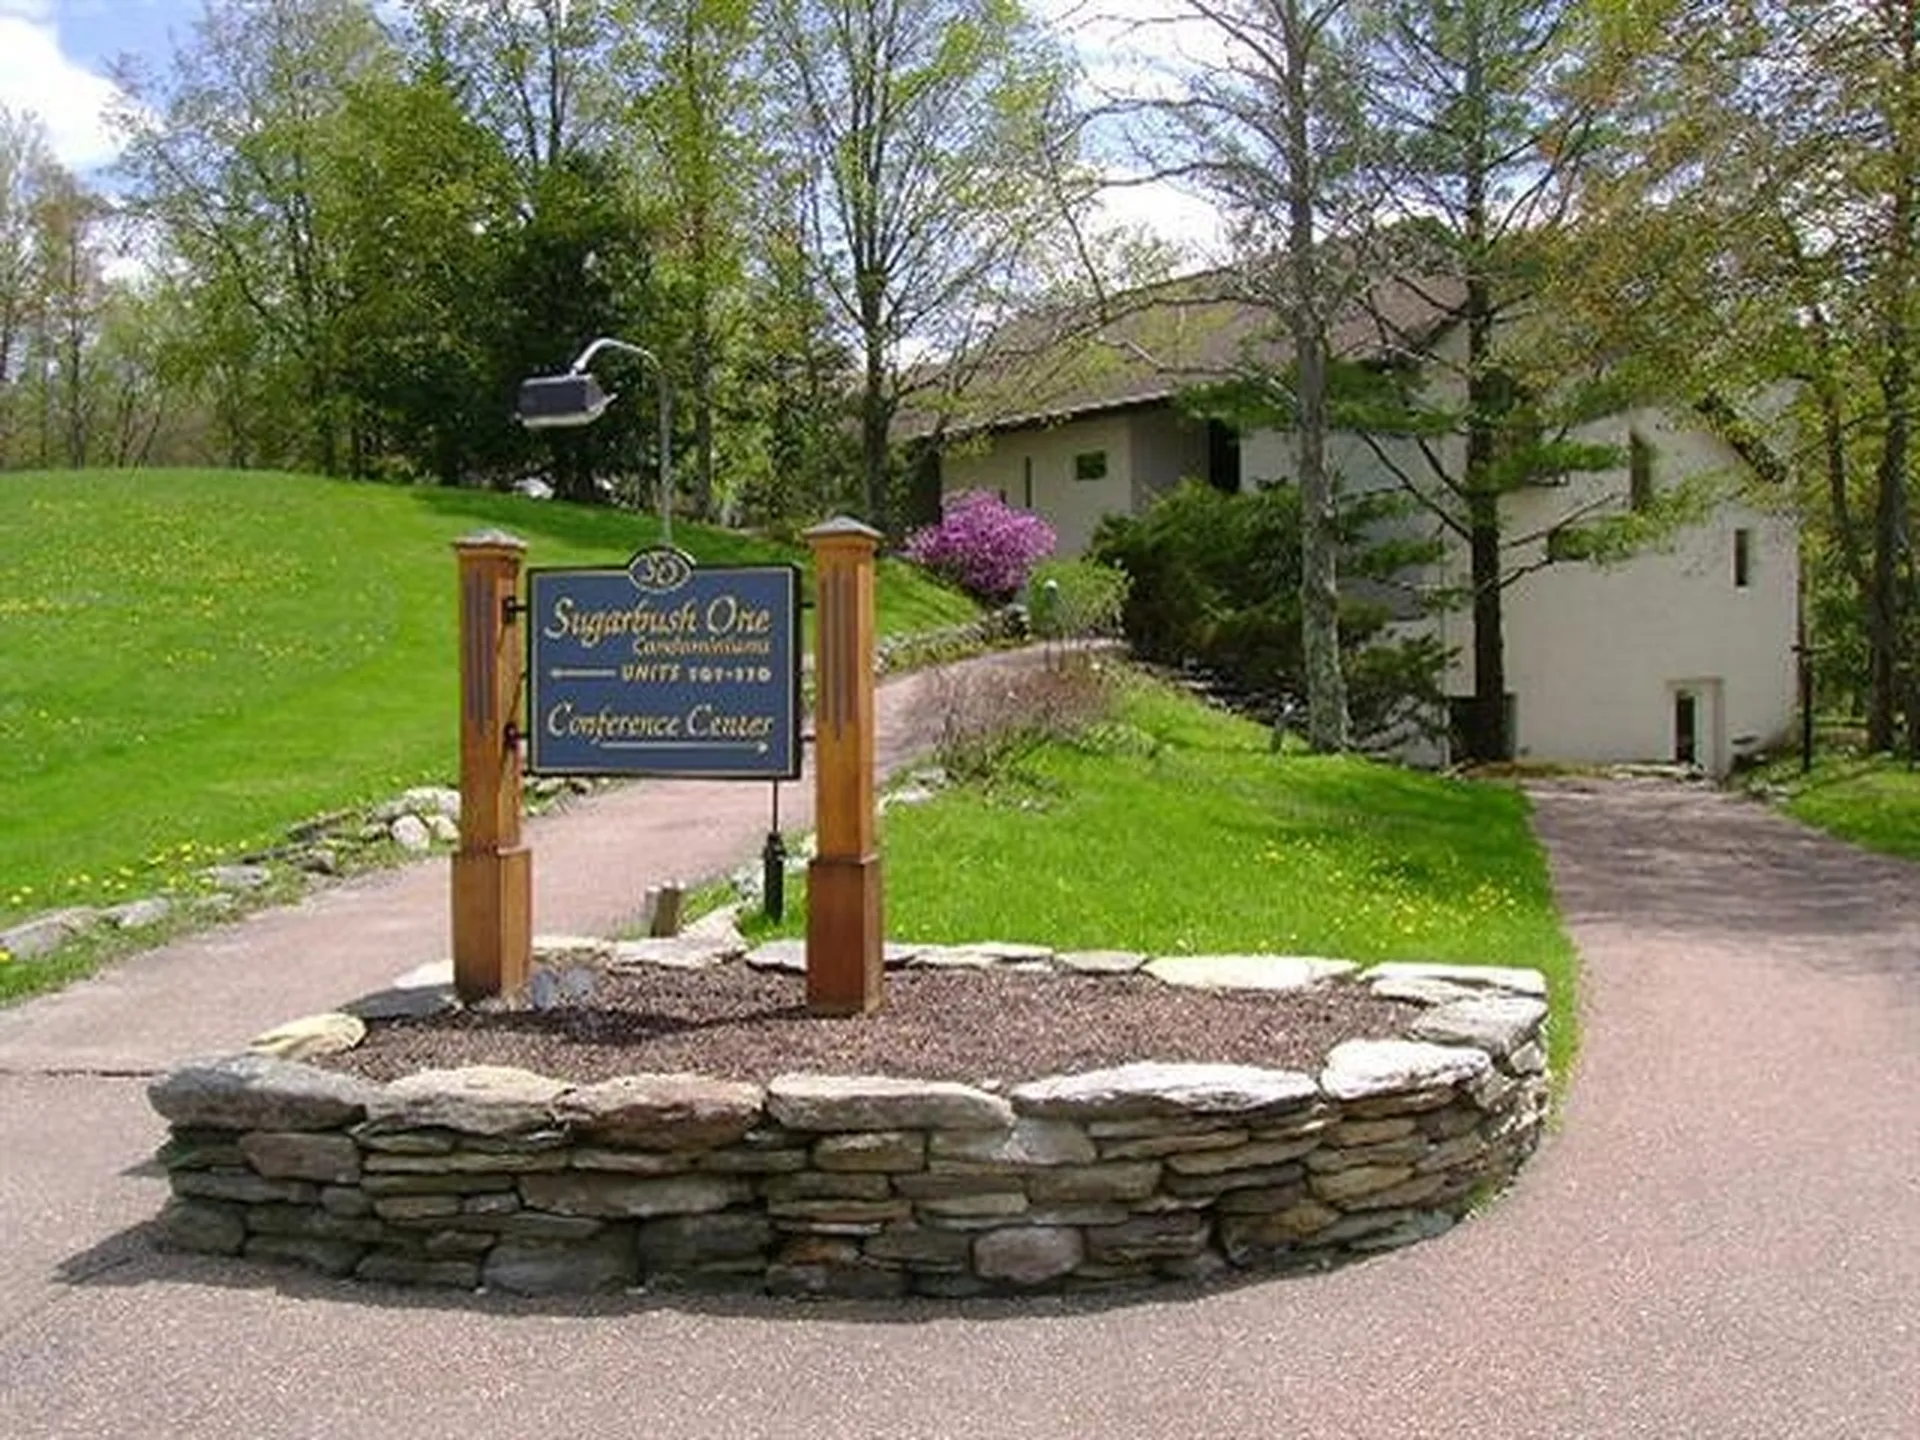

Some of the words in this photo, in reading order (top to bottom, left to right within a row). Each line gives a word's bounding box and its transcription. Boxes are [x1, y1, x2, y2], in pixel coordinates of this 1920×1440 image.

[544, 597, 697, 648] Sugarbush
[706, 595, 771, 634] One
[621, 664, 682, 682] UNITS
[548, 700, 680, 743] Conference
[686, 704, 774, 738] Center
